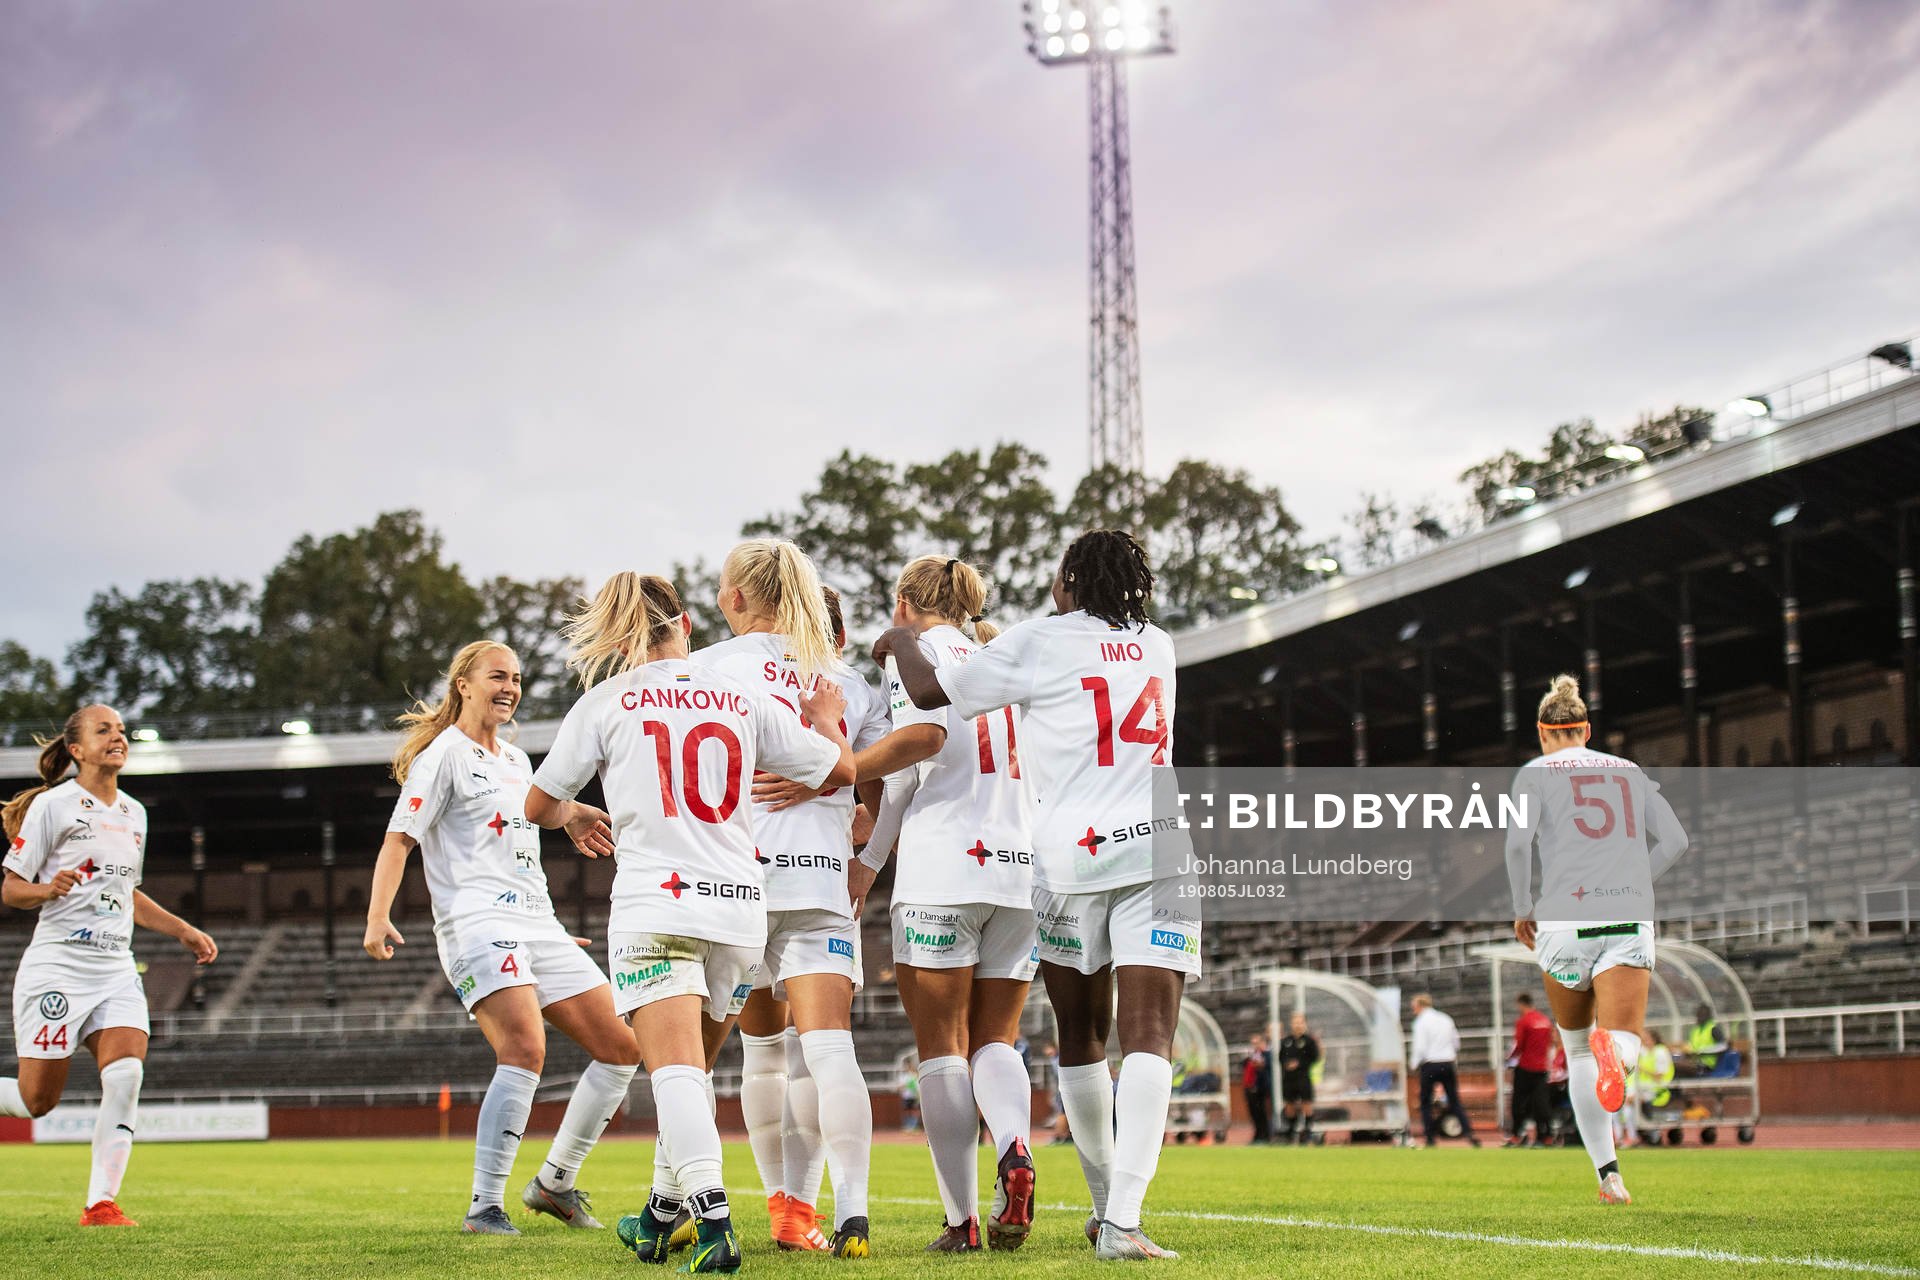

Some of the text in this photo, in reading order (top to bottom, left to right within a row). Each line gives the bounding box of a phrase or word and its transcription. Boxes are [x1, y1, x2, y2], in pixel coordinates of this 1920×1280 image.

[1100, 642, 1143, 662] IMO
[621, 688, 749, 717] CANKOVIC
[1081, 676, 1168, 767] 14
[977, 704, 1021, 780] 11
[643, 720, 743, 824] 10
[1569, 774, 1636, 840] 51
[1155, 932, 1184, 948] MKB
[500, 953, 519, 978] 4
[33, 1024, 68, 1051] 44
